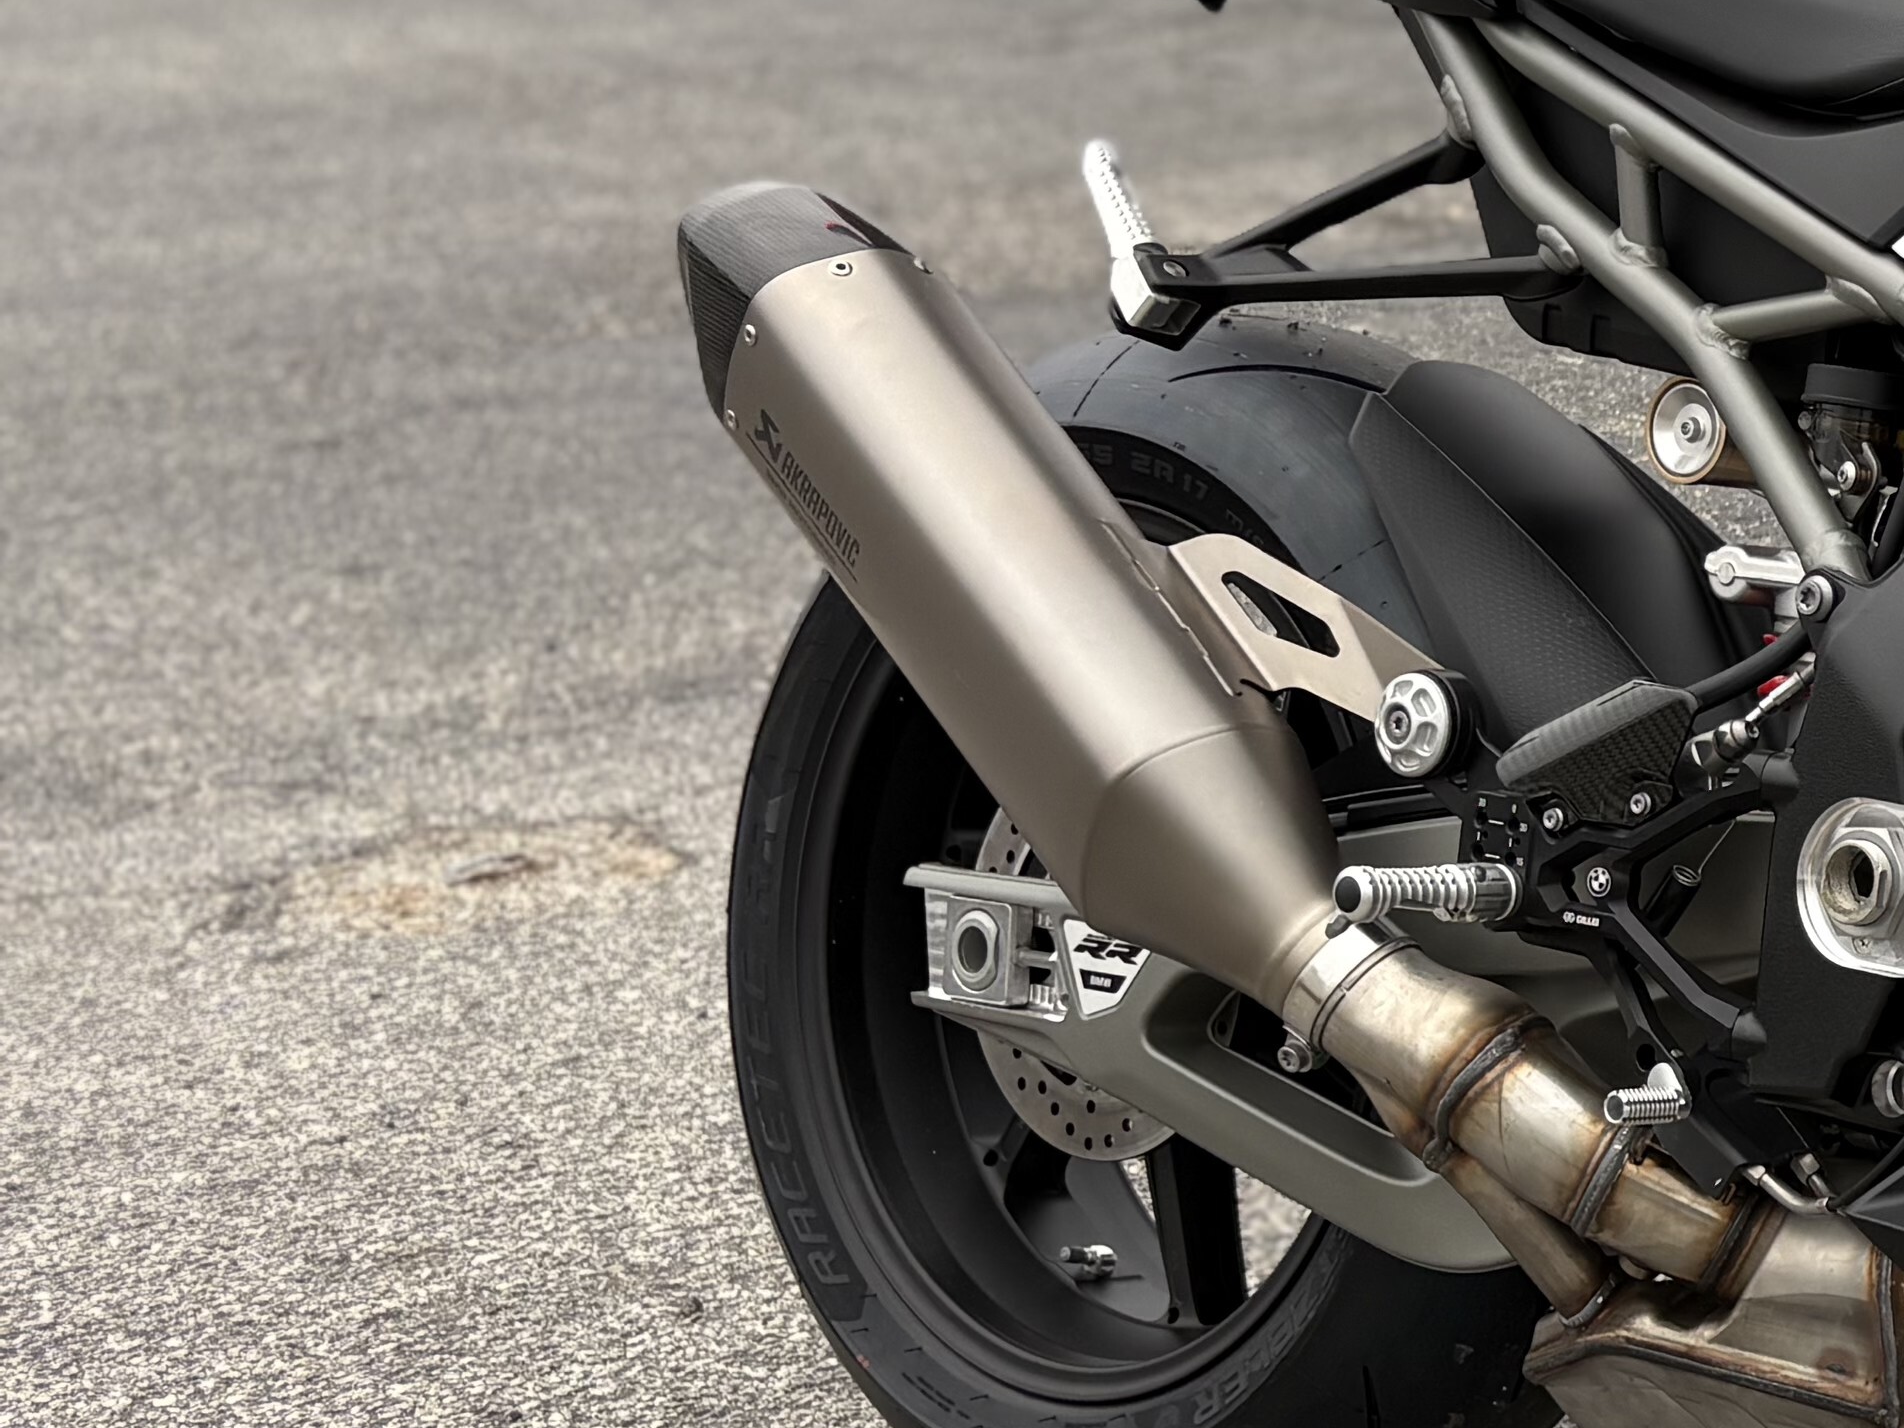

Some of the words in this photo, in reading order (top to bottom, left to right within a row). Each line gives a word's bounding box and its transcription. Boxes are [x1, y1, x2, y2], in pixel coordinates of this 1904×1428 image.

[1178, 472, 1212, 501] 17
[1073, 937, 1143, 965] RR
[741, 950, 849, 1284] RACETEC
